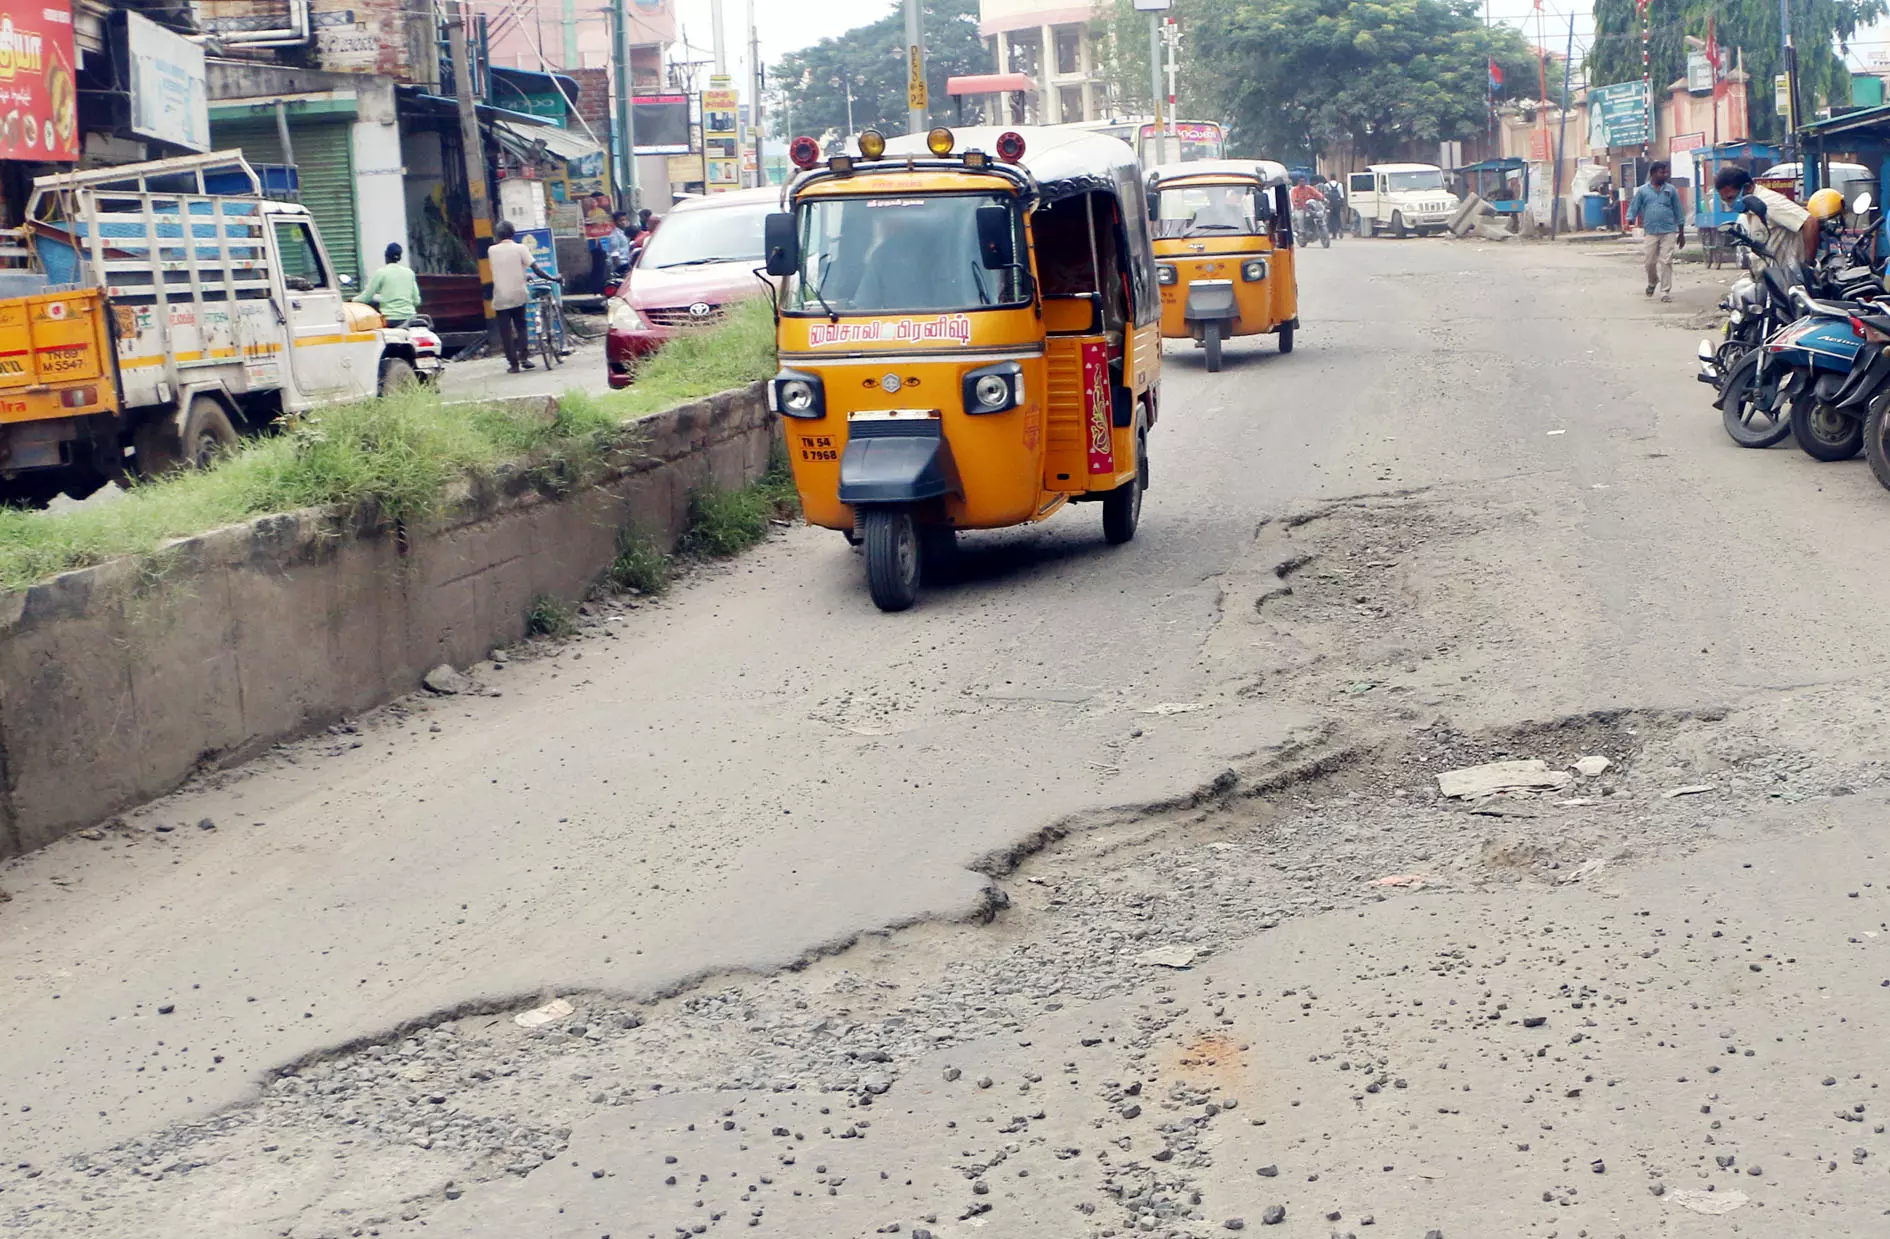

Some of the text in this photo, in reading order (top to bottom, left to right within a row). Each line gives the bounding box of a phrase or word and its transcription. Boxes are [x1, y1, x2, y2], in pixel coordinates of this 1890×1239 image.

[810, 321, 880, 346] வைசாலி
[801, 437, 814, 448] TN
[810, 450, 837, 460] 7968
